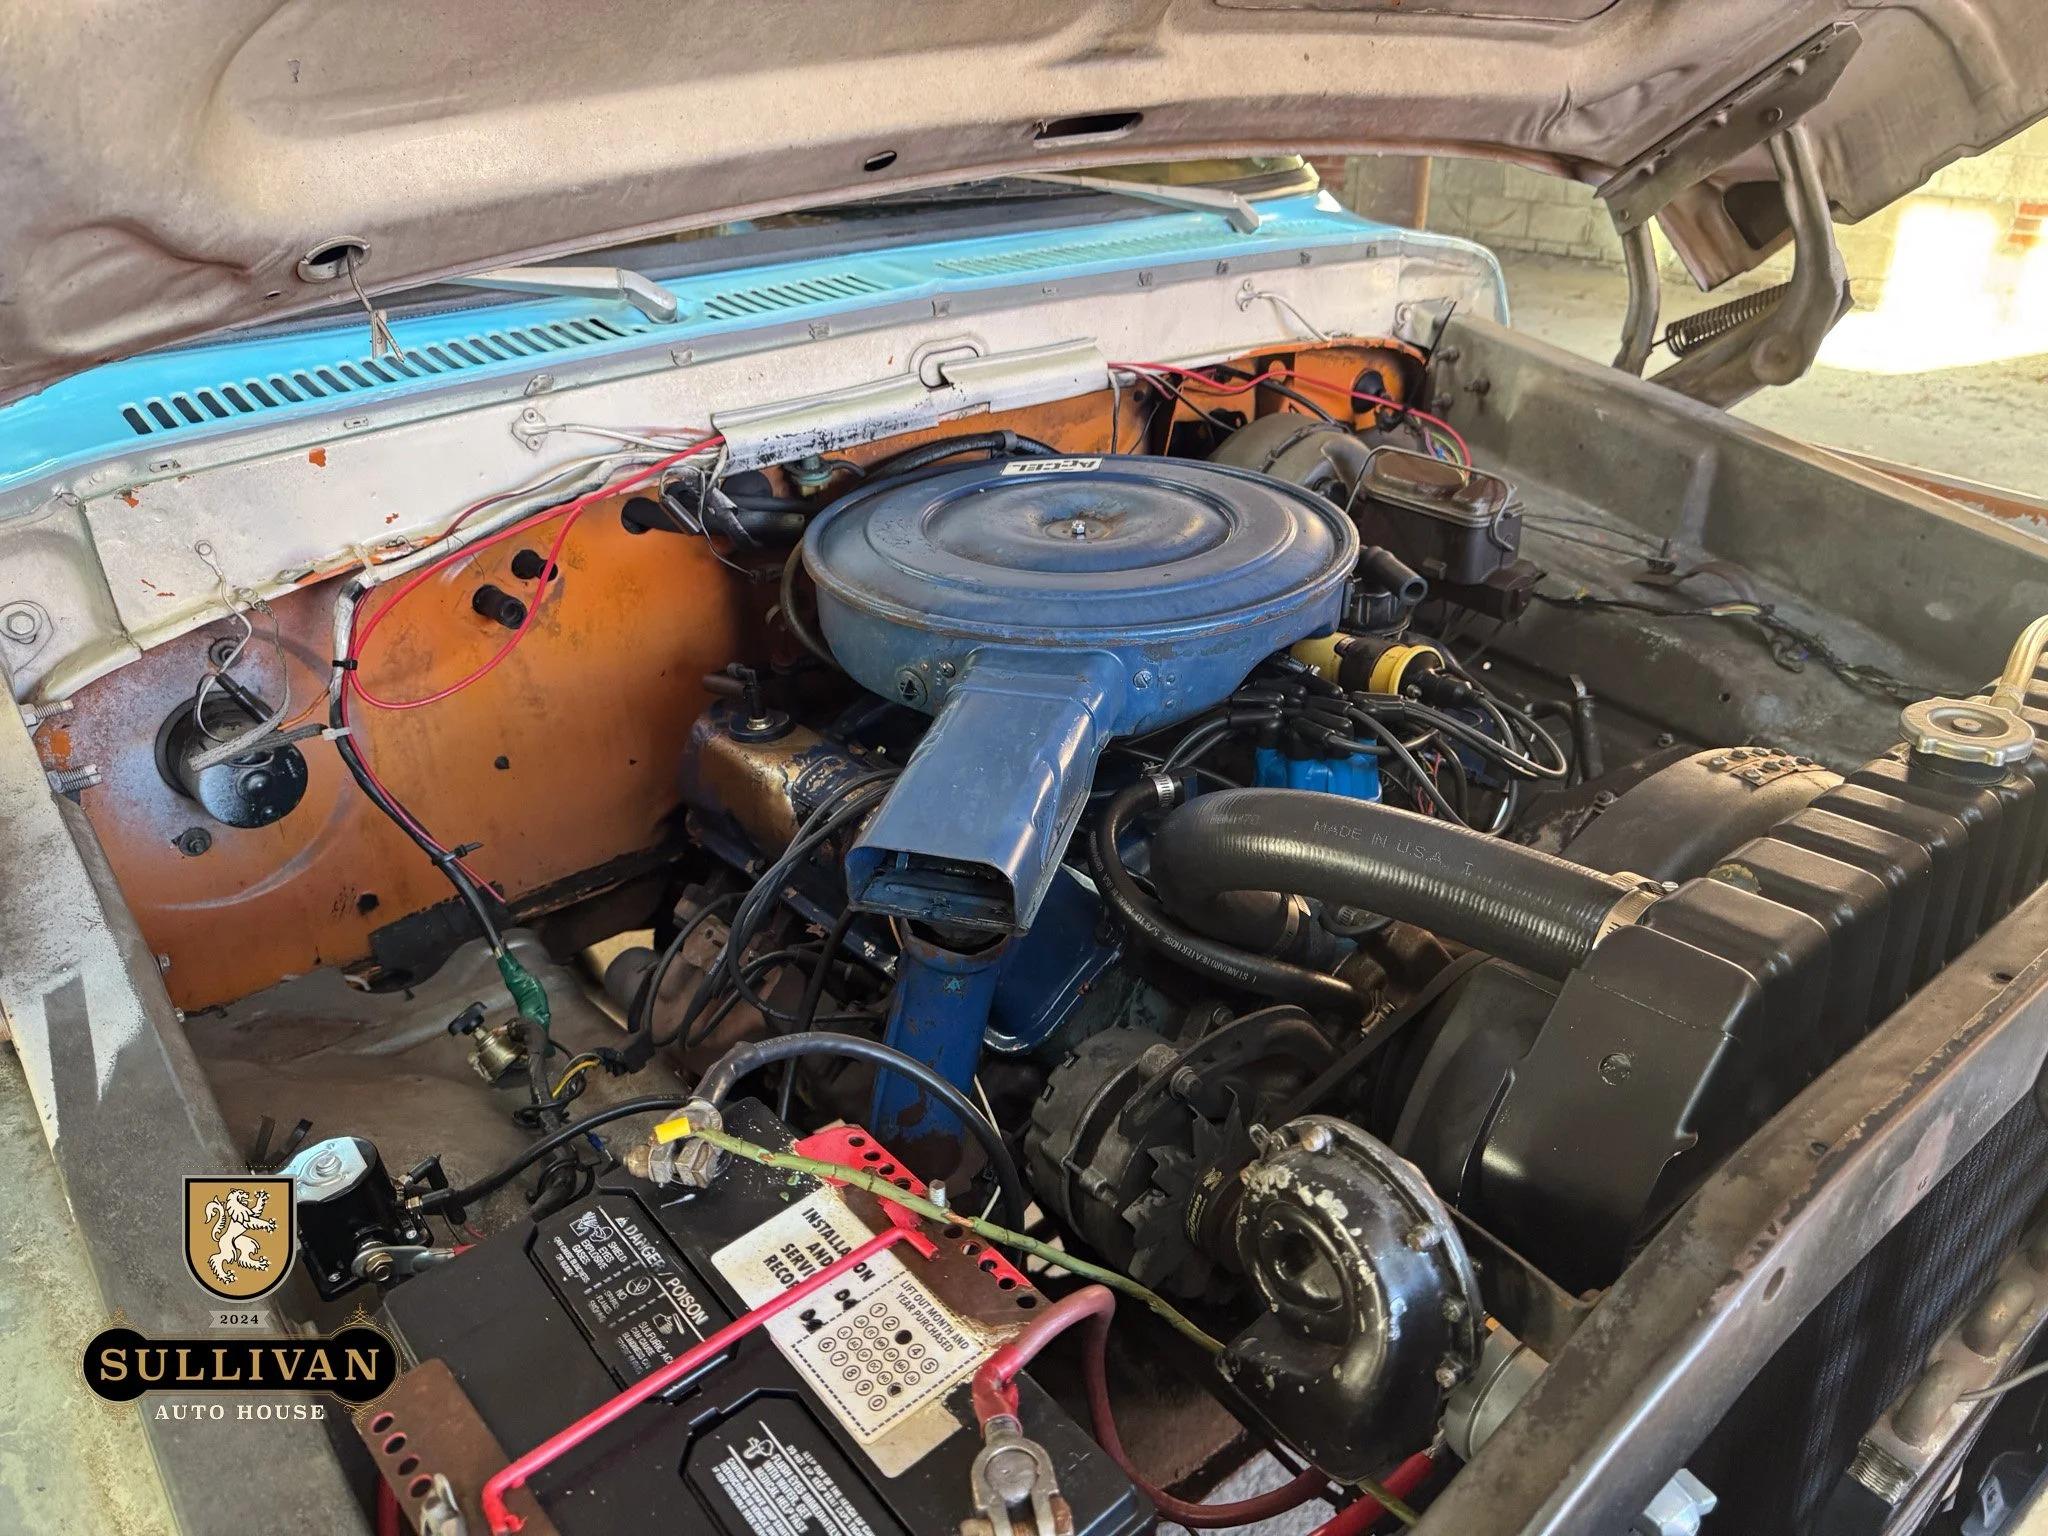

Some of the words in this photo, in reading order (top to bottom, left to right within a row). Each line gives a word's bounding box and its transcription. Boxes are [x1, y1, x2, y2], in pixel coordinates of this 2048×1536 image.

[1313, 821, 1362, 841] MADE
[1371, 833, 1388, 848] IN
[581, 1239, 608, 1270] EXPLOSIVE
[607, 1241, 627, 1262] SHIELD
[780, 1243, 816, 1277] SERVI
[802, 1207, 875, 1282] INSTALLAON
[805, 1242, 834, 1272] AND
[763, 1254, 800, 1293] RECO
[615, 1289, 628, 1300] NO
[665, 1277, 709, 1325] POISON
[896, 1292, 916, 1312] YEAR
[911, 1309, 954, 1352] PURCHASED
[900, 1280, 918, 1296] LIFT
[913, 1294, 932, 1309] OUT
[926, 1307, 955, 1335] MONTH
[950, 1333, 969, 1350] AND
[630, 1327, 643, 1339] CAN
[638, 1337, 655, 1357] CAUSE
[638, 1321, 666, 1353] SULFURIC
[771, 1453, 793, 1478] FLUSH
[788, 1475, 806, 1495] EYES
[813, 1465, 827, 1478] OUT
[753, 1467, 780, 1499] MEDICAL
[775, 1495, 794, 1514] HELP
[789, 1513, 808, 1533] FAST
[763, 1460, 781, 1480] WITH
[796, 1503, 812, 1519] GET
